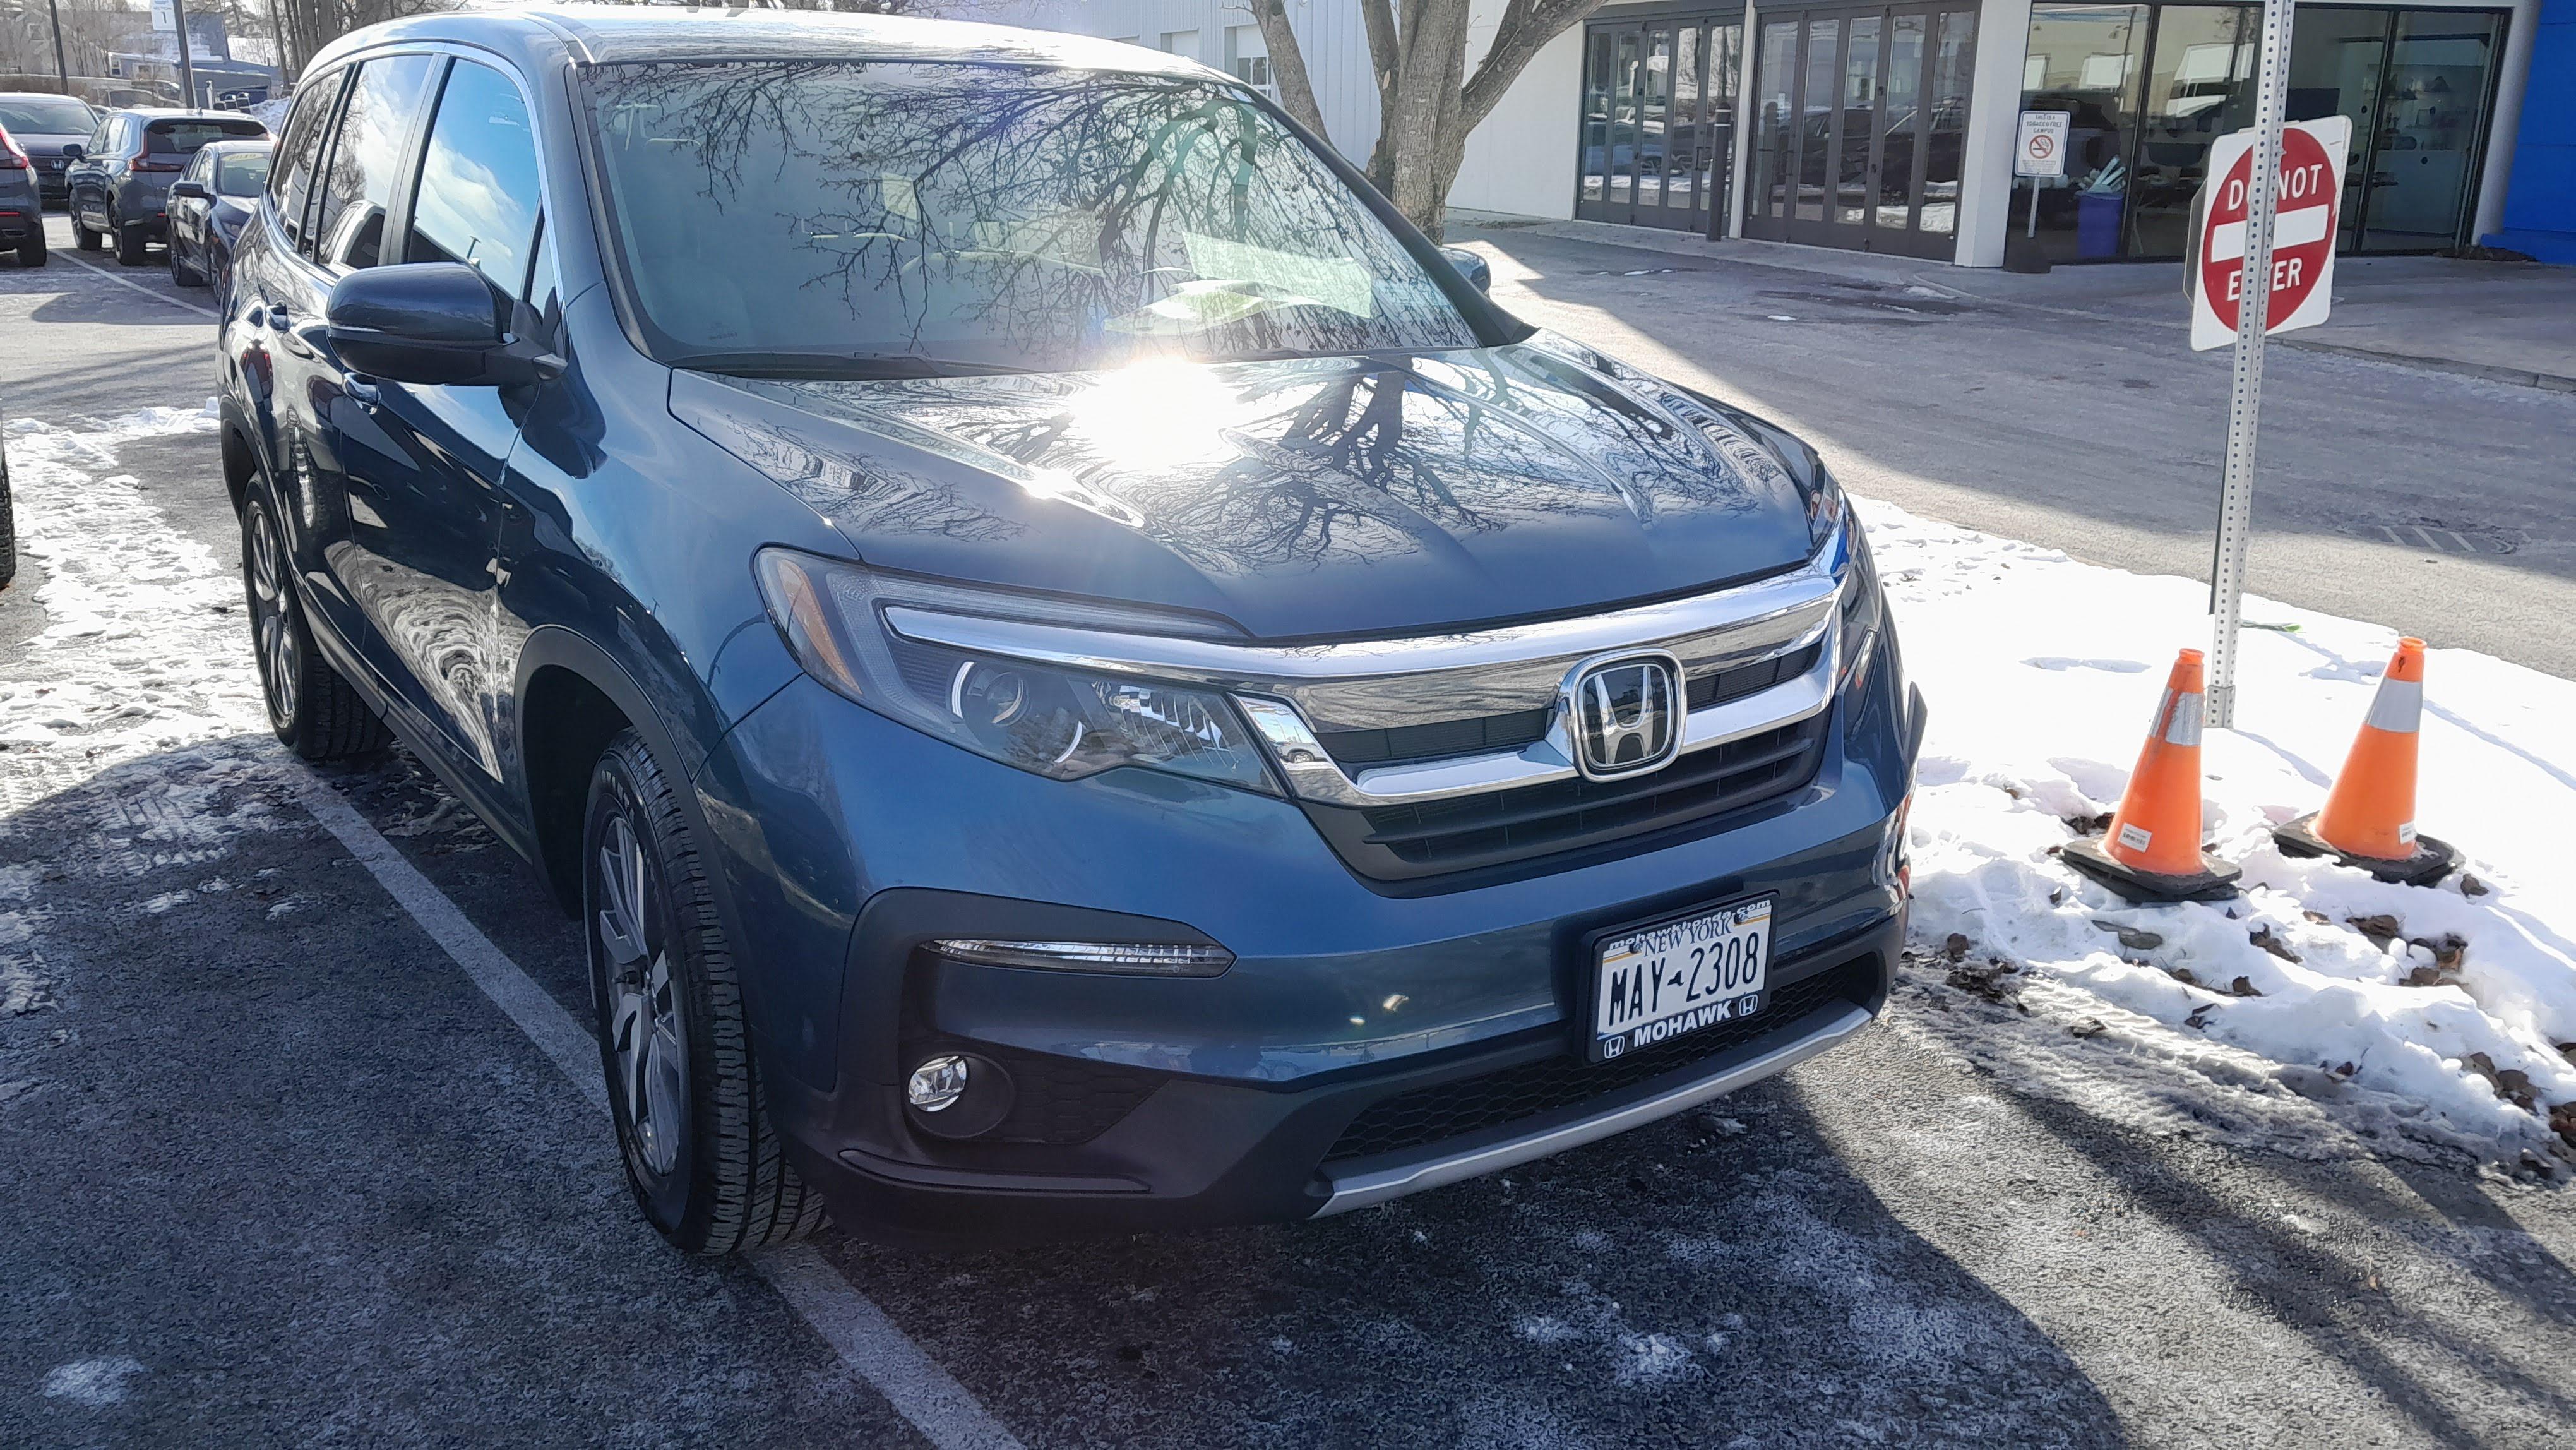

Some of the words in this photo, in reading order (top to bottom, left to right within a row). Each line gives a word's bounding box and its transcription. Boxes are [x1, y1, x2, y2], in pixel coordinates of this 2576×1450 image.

[2227, 179, 2250, 212] D
[2278, 164, 2323, 200] NOT
[2227, 257, 2303, 301] EER
[1609, 899, 1771, 950] mohawkhonda.com
[1644, 927, 1685, 957] NEW
[1686, 916, 1732, 945] YORK
[1633, 1000, 1732, 1048] MOHAWK
